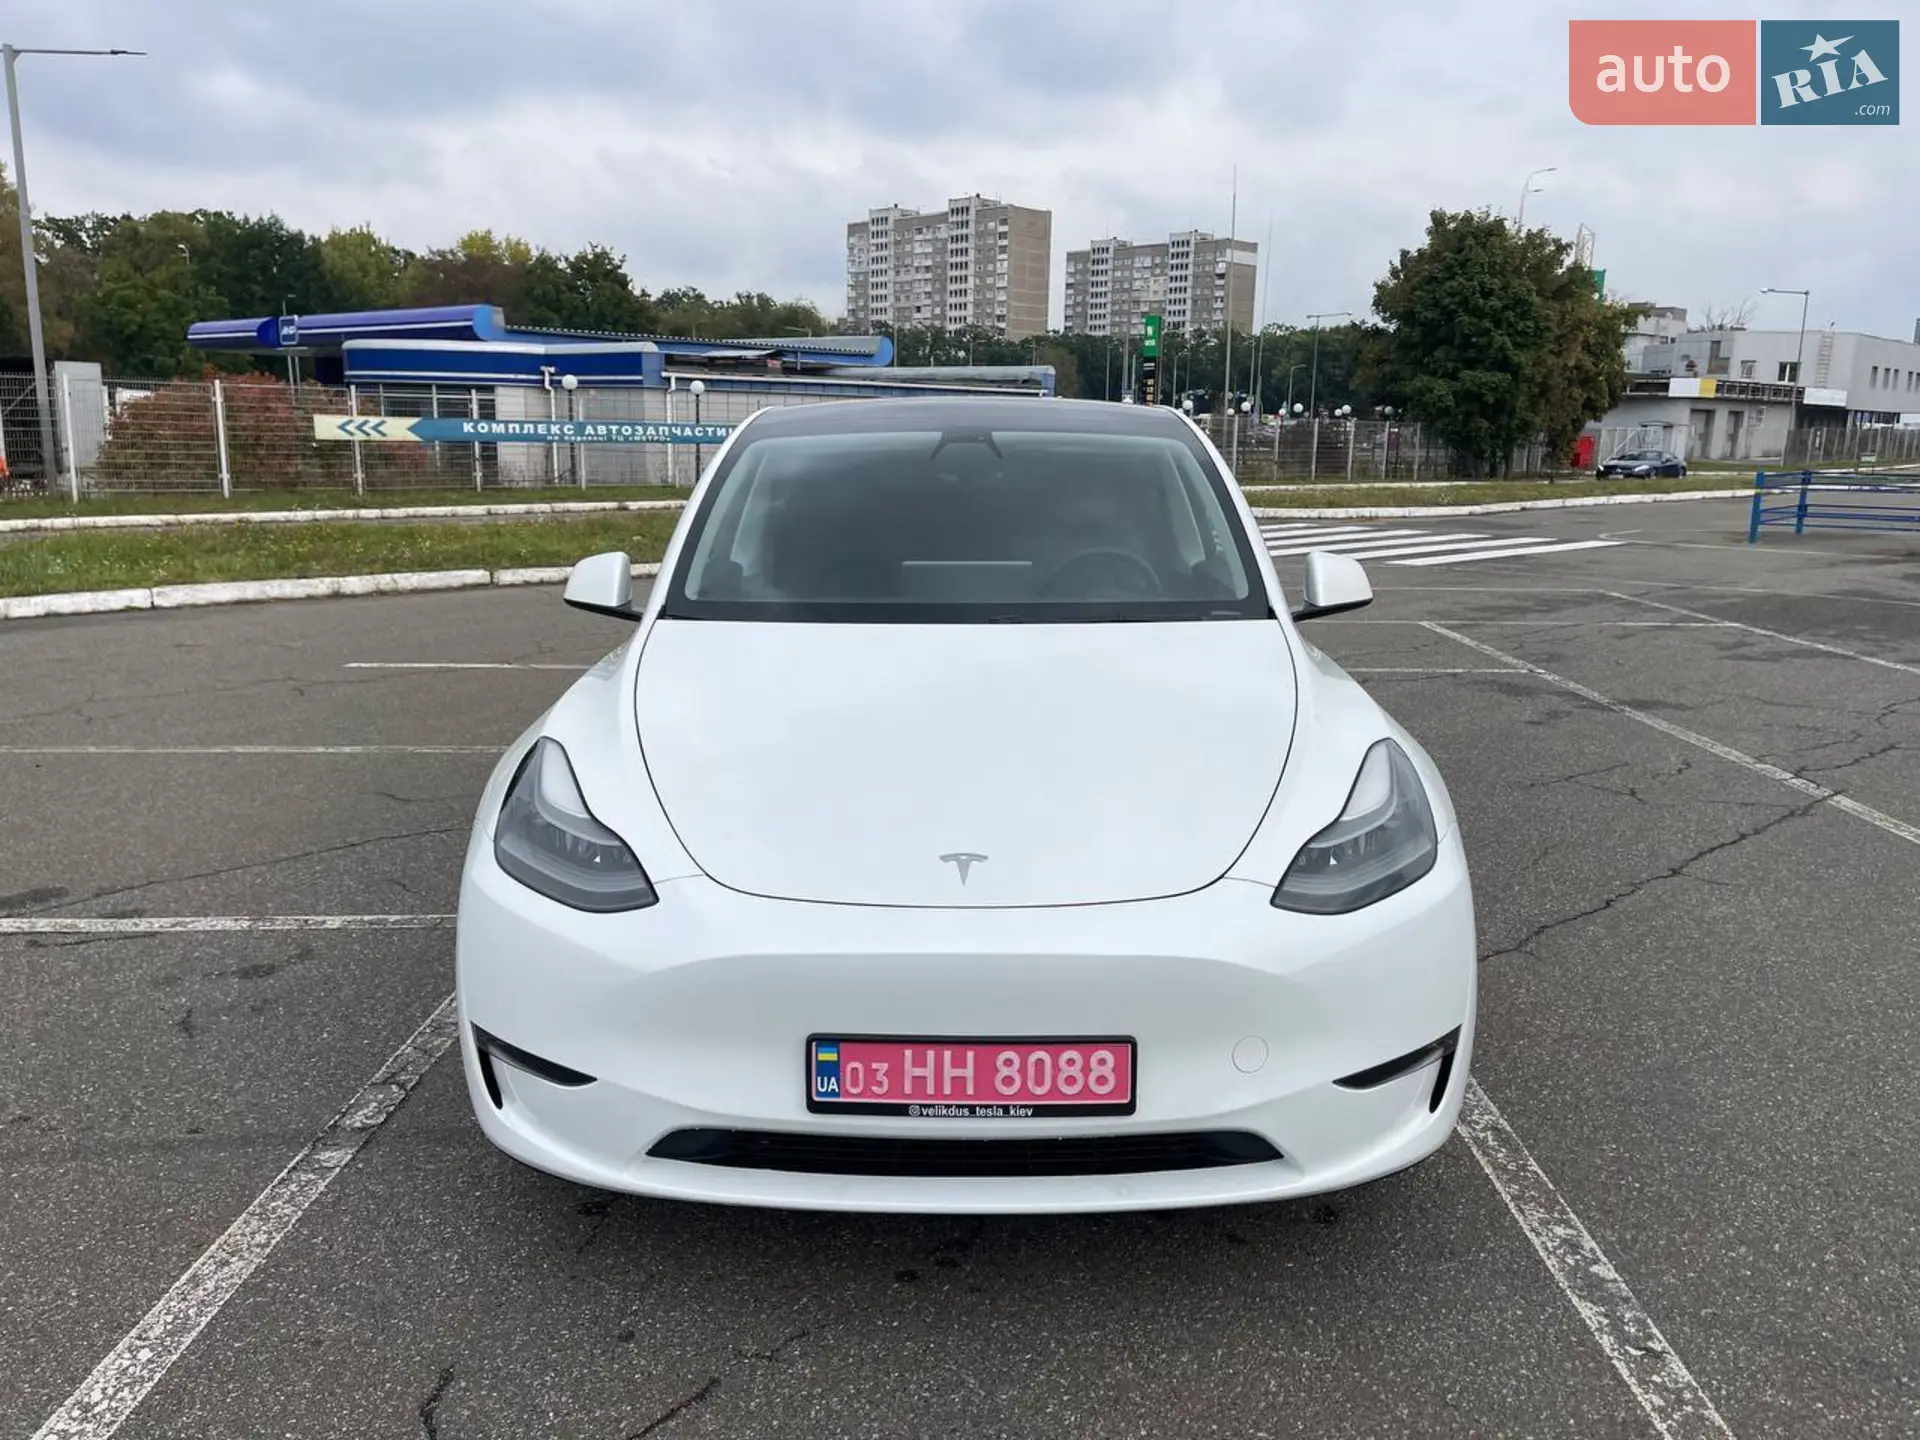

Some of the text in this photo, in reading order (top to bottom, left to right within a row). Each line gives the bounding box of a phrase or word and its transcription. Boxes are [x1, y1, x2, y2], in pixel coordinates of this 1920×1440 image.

[463, 422, 575, 435] КОМПЛЕКС
[845, 1049, 1116, 1096] 03 HH 8088
[817, 1076, 839, 1093] UA
